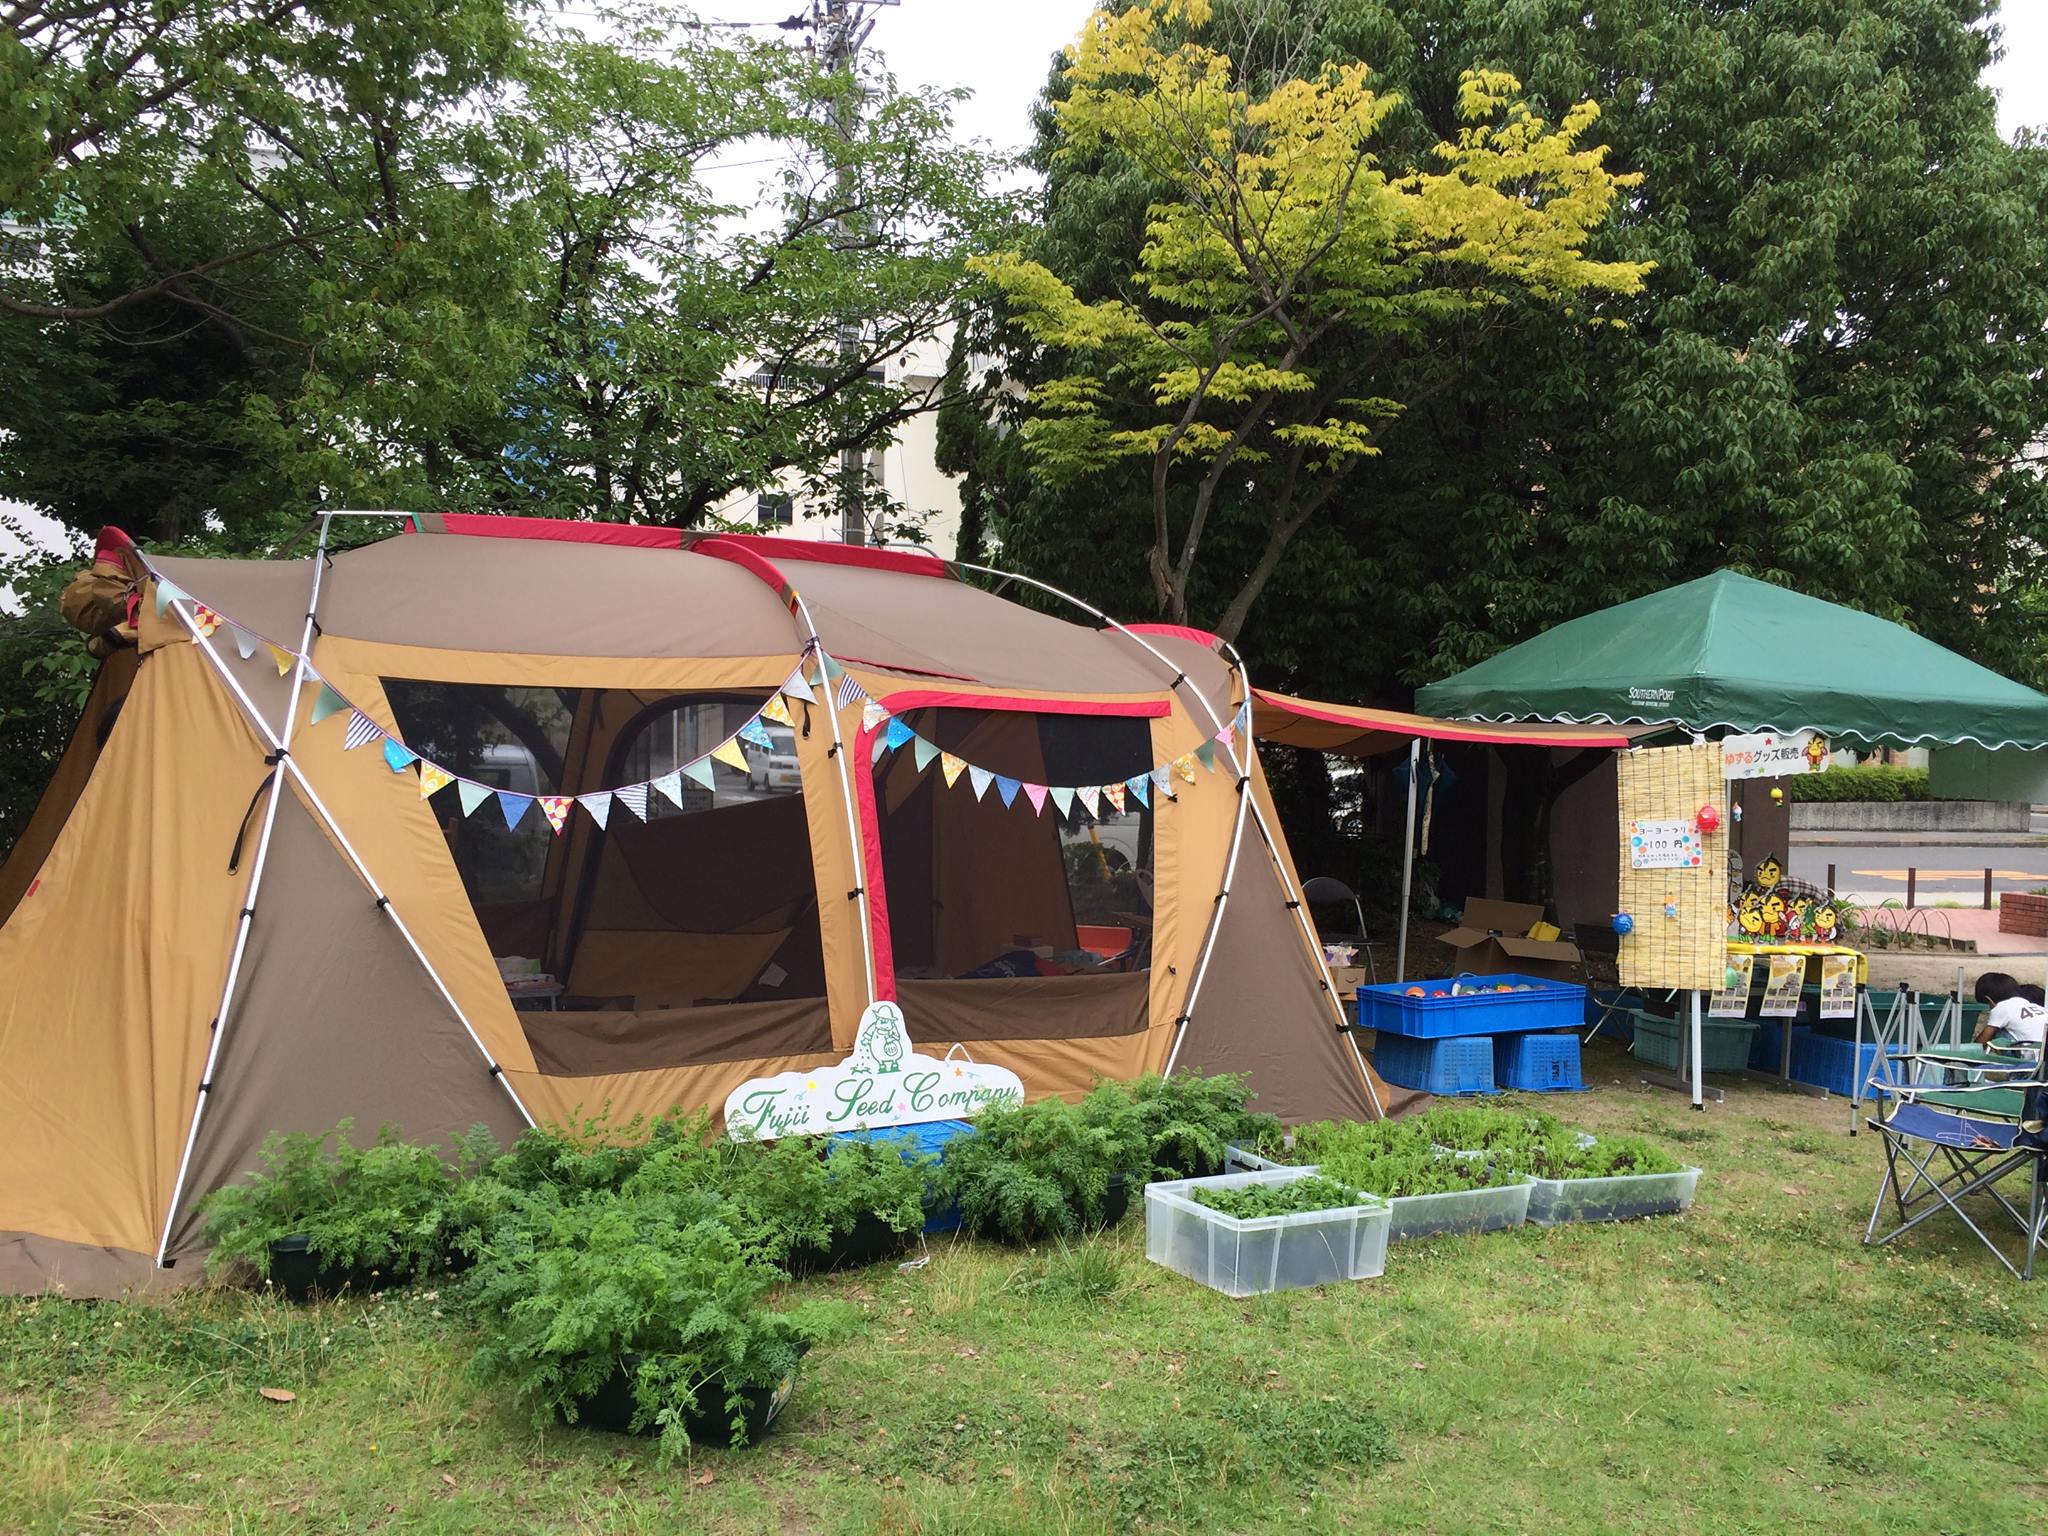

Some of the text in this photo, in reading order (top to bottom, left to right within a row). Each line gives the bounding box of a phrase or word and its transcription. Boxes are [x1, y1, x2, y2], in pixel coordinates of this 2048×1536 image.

[1639, 822, 1686, 835] ヨーヨーつり
[743, 1072, 1019, 1137] Fujii Seed Company
